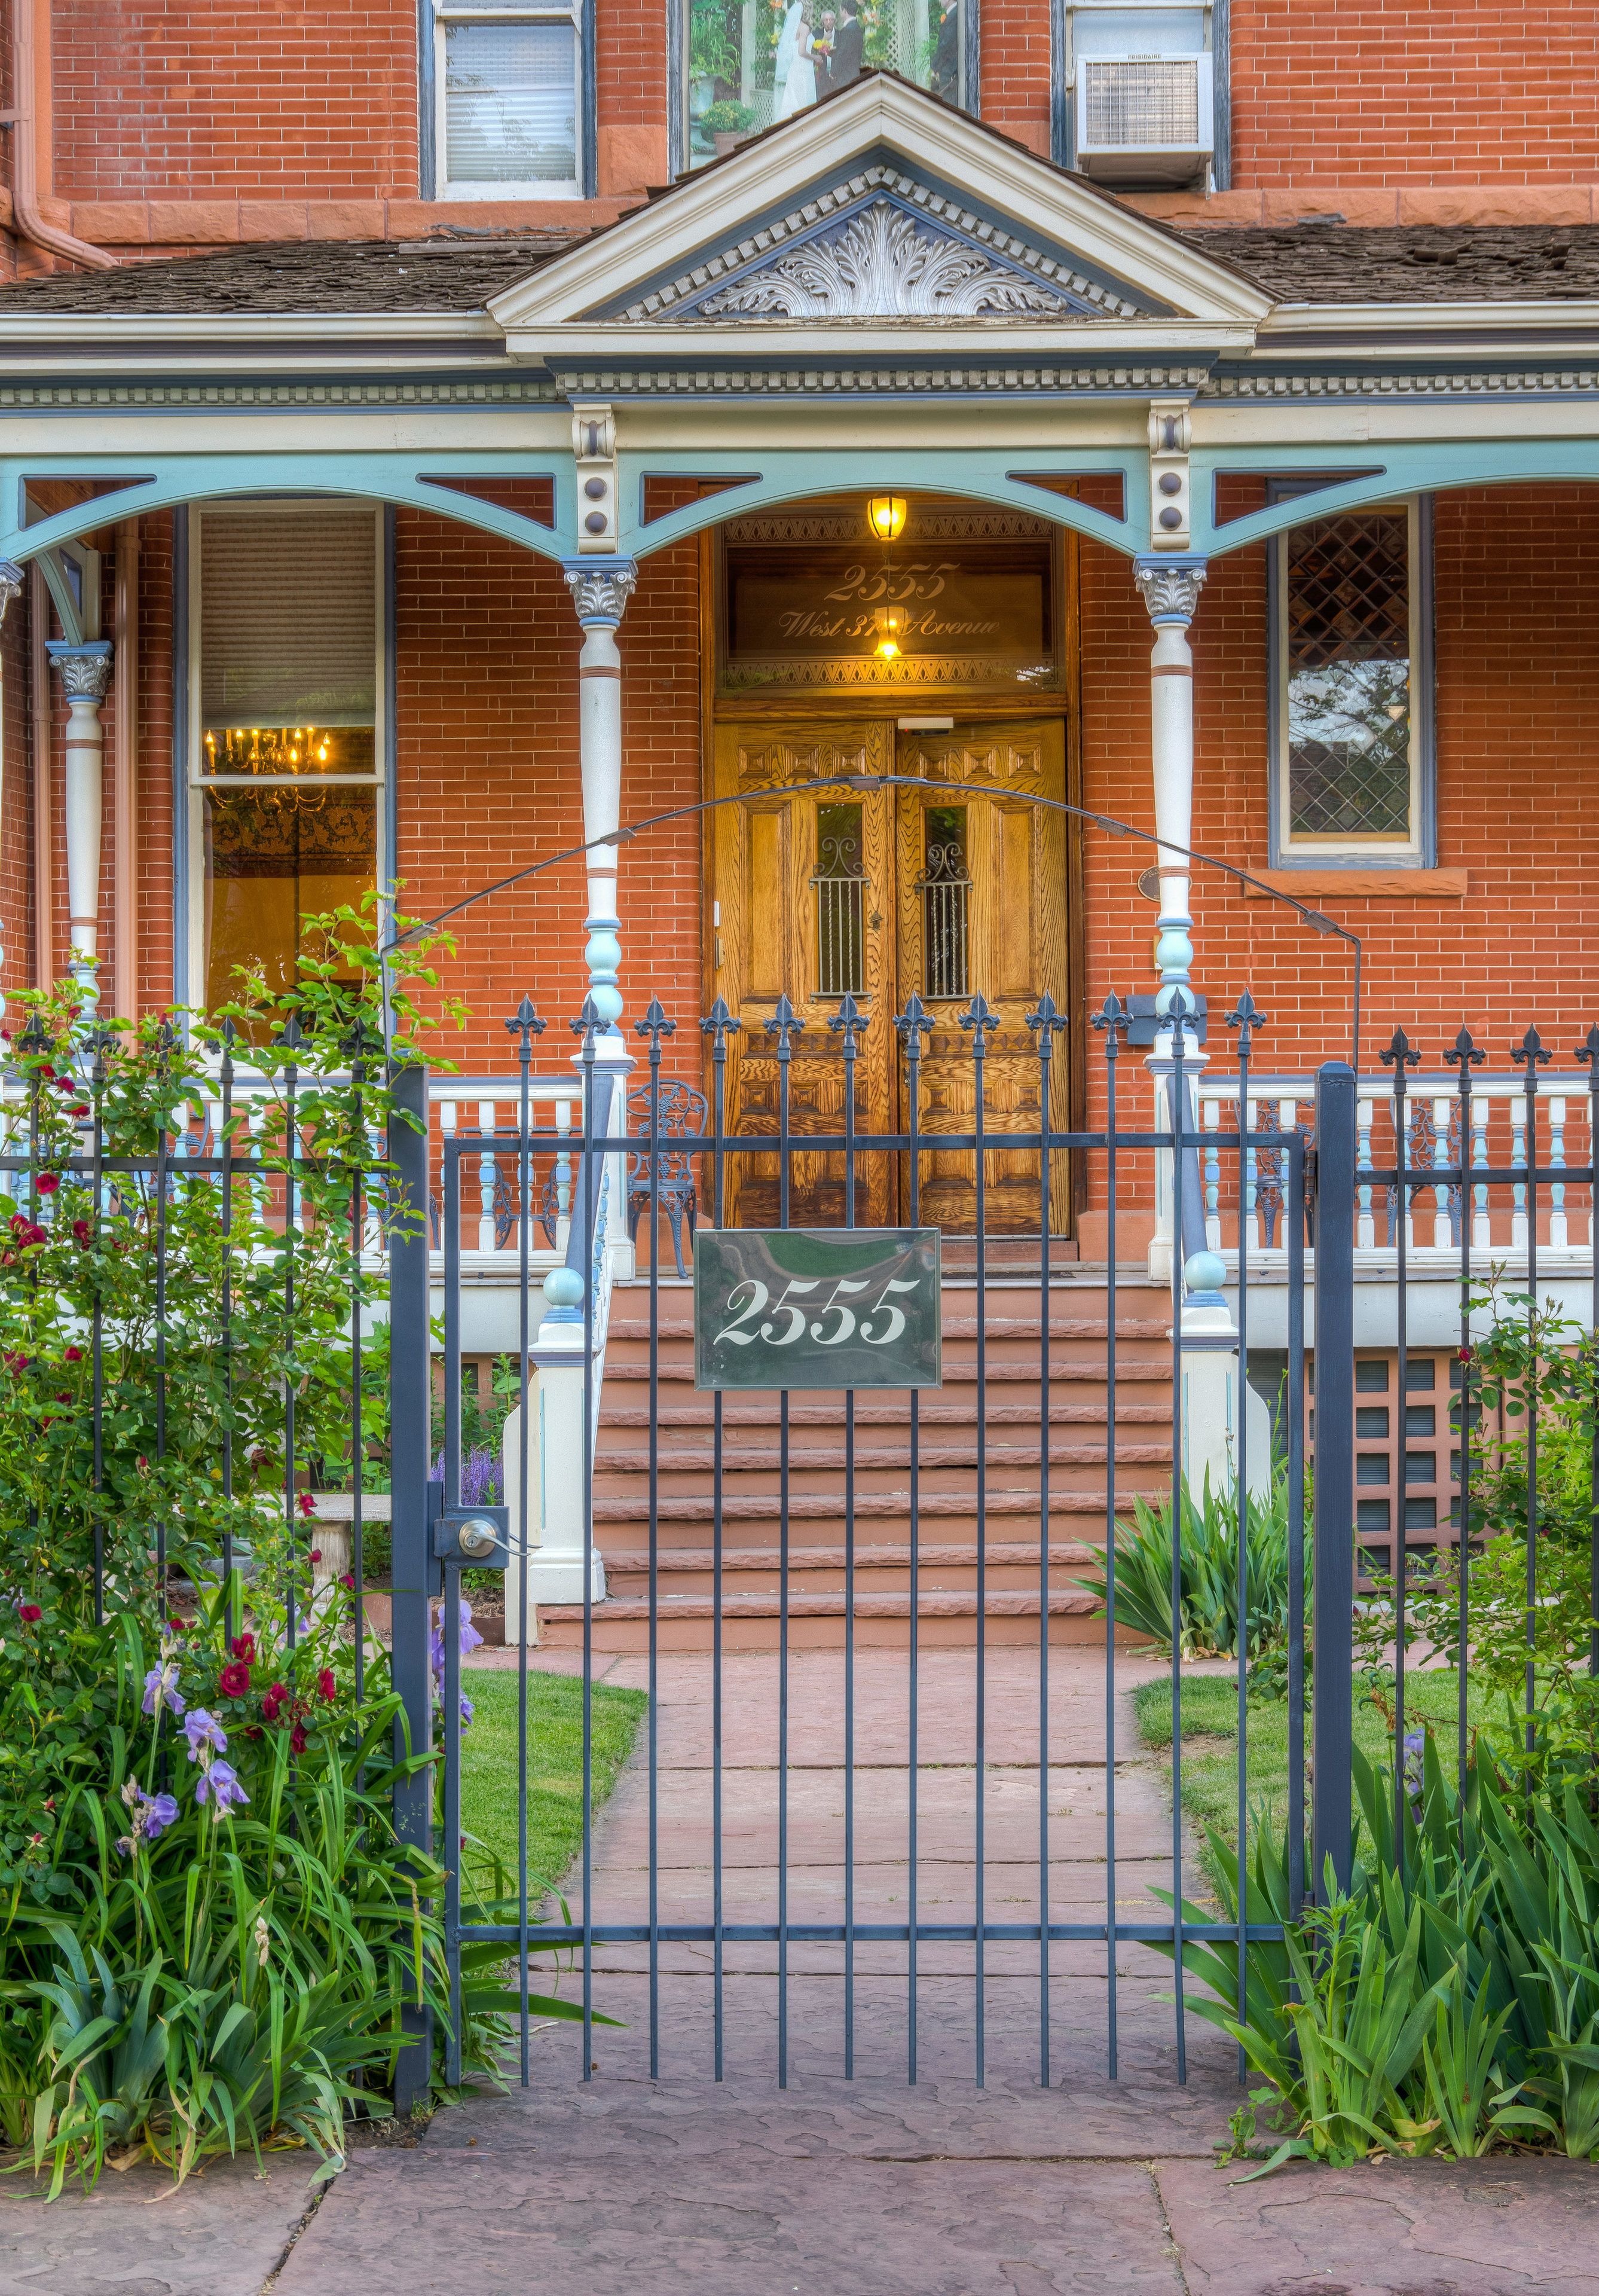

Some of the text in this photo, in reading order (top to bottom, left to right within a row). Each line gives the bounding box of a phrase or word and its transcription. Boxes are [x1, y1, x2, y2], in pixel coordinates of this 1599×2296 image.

[824, 563, 961, 601] 2555
[779, 610, 846, 637] West
[897, 609, 1000, 636] Avenue
[713, 1278, 922, 1345] 2555
